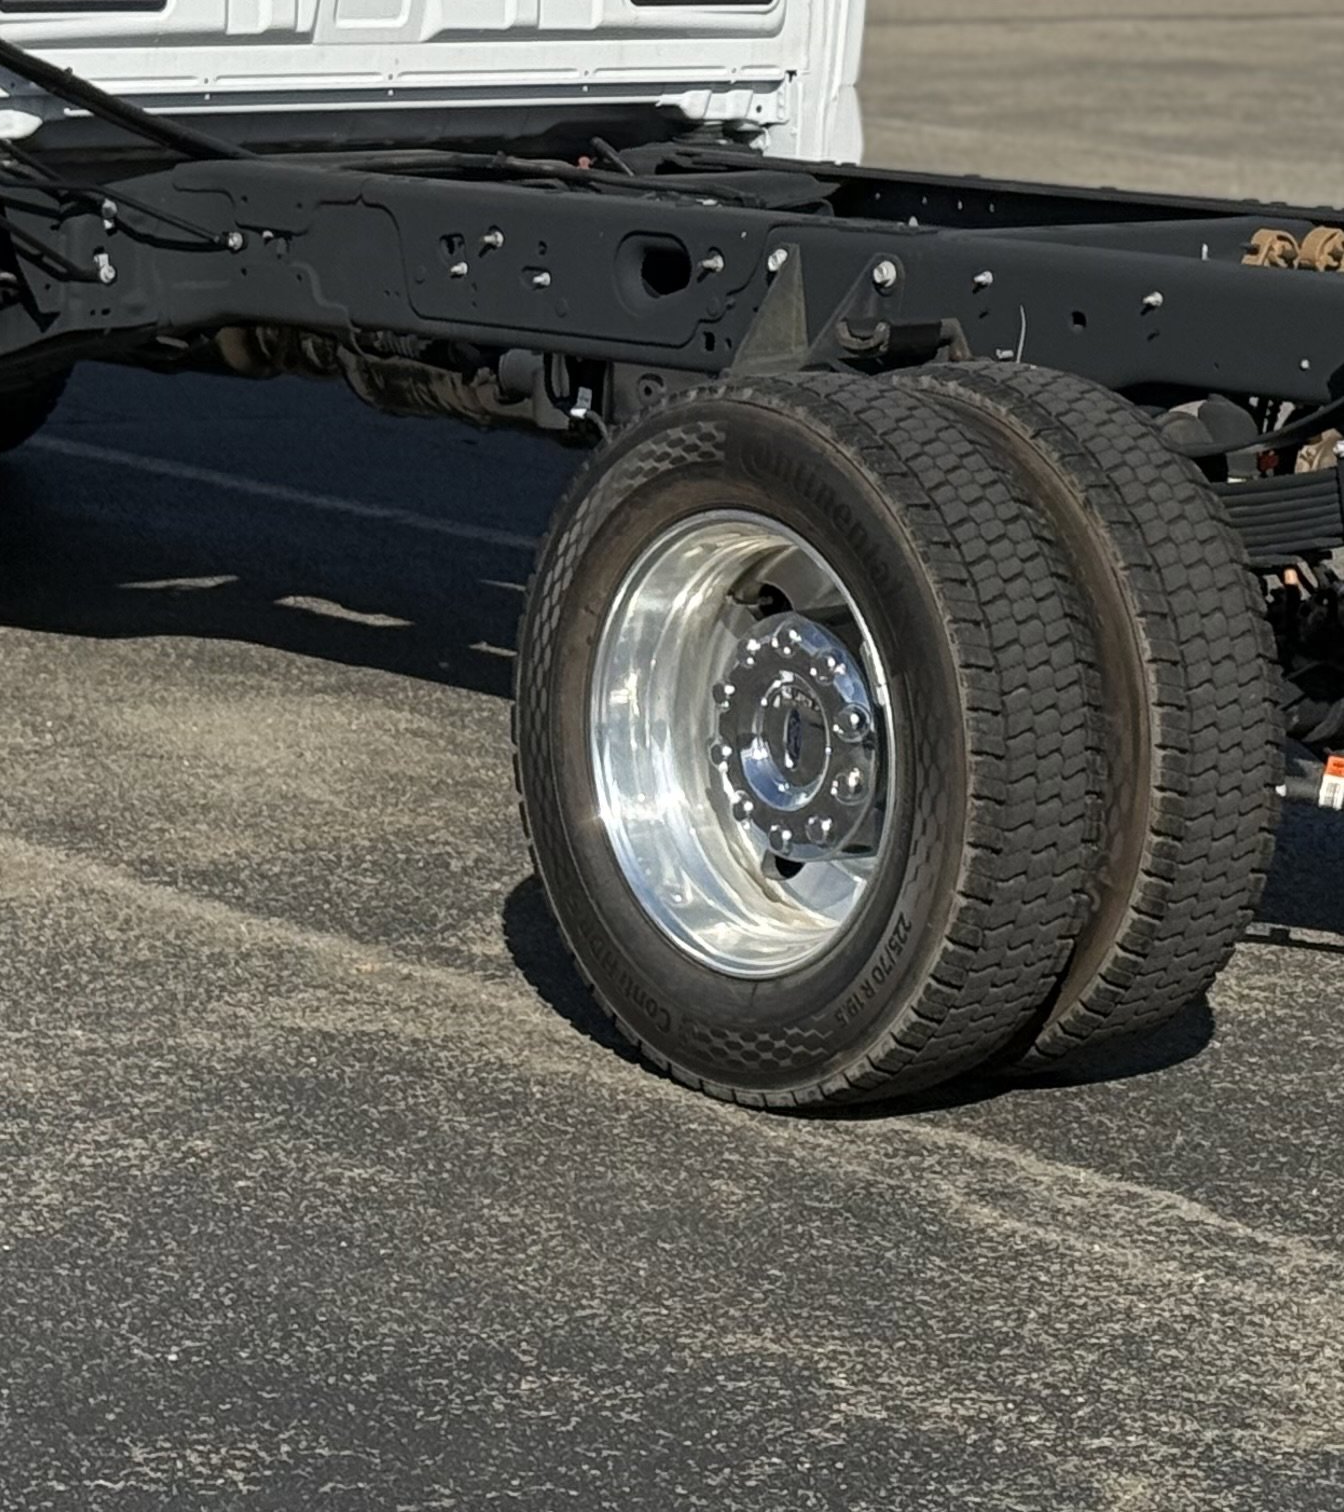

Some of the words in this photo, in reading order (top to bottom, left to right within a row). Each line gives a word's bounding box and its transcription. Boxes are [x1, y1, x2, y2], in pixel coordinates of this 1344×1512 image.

[738, 438, 909, 604] Continental
[869, 910, 913, 987] 225/70
[615, 970, 673, 1035] Conti
[859, 978, 876, 1001] R
